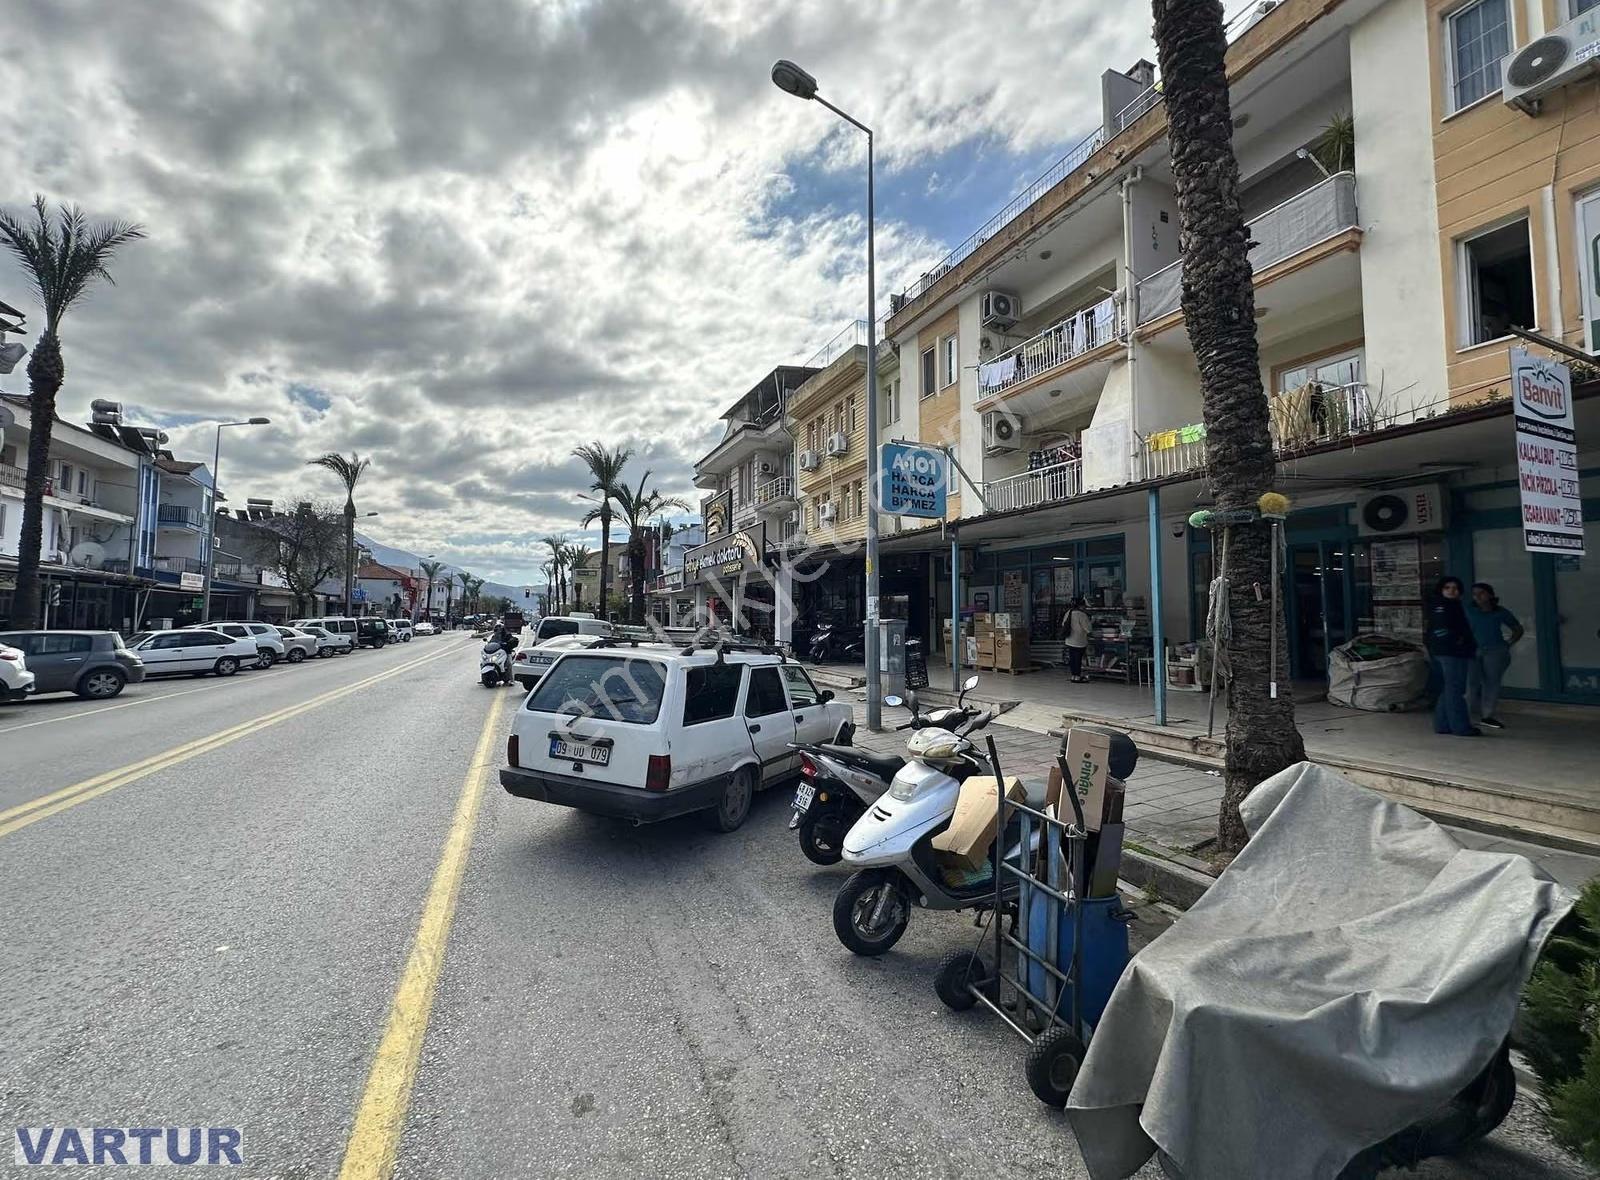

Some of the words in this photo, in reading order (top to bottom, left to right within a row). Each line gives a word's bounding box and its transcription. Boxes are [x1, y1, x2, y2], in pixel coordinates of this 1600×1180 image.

[1522, 377, 1563, 410] Banvit
[892, 471, 936, 486] HARCA
[892, 484, 936, 499] HARCA
[1416, 494, 1428, 525] VESTEL
[699, 552, 716, 569] ekmek
[716, 546, 742, 565] doktoru
[556, 742, 567, 755] 09
[590, 747, 607, 762] 079
[1078, 760, 1092, 796] PINAR
